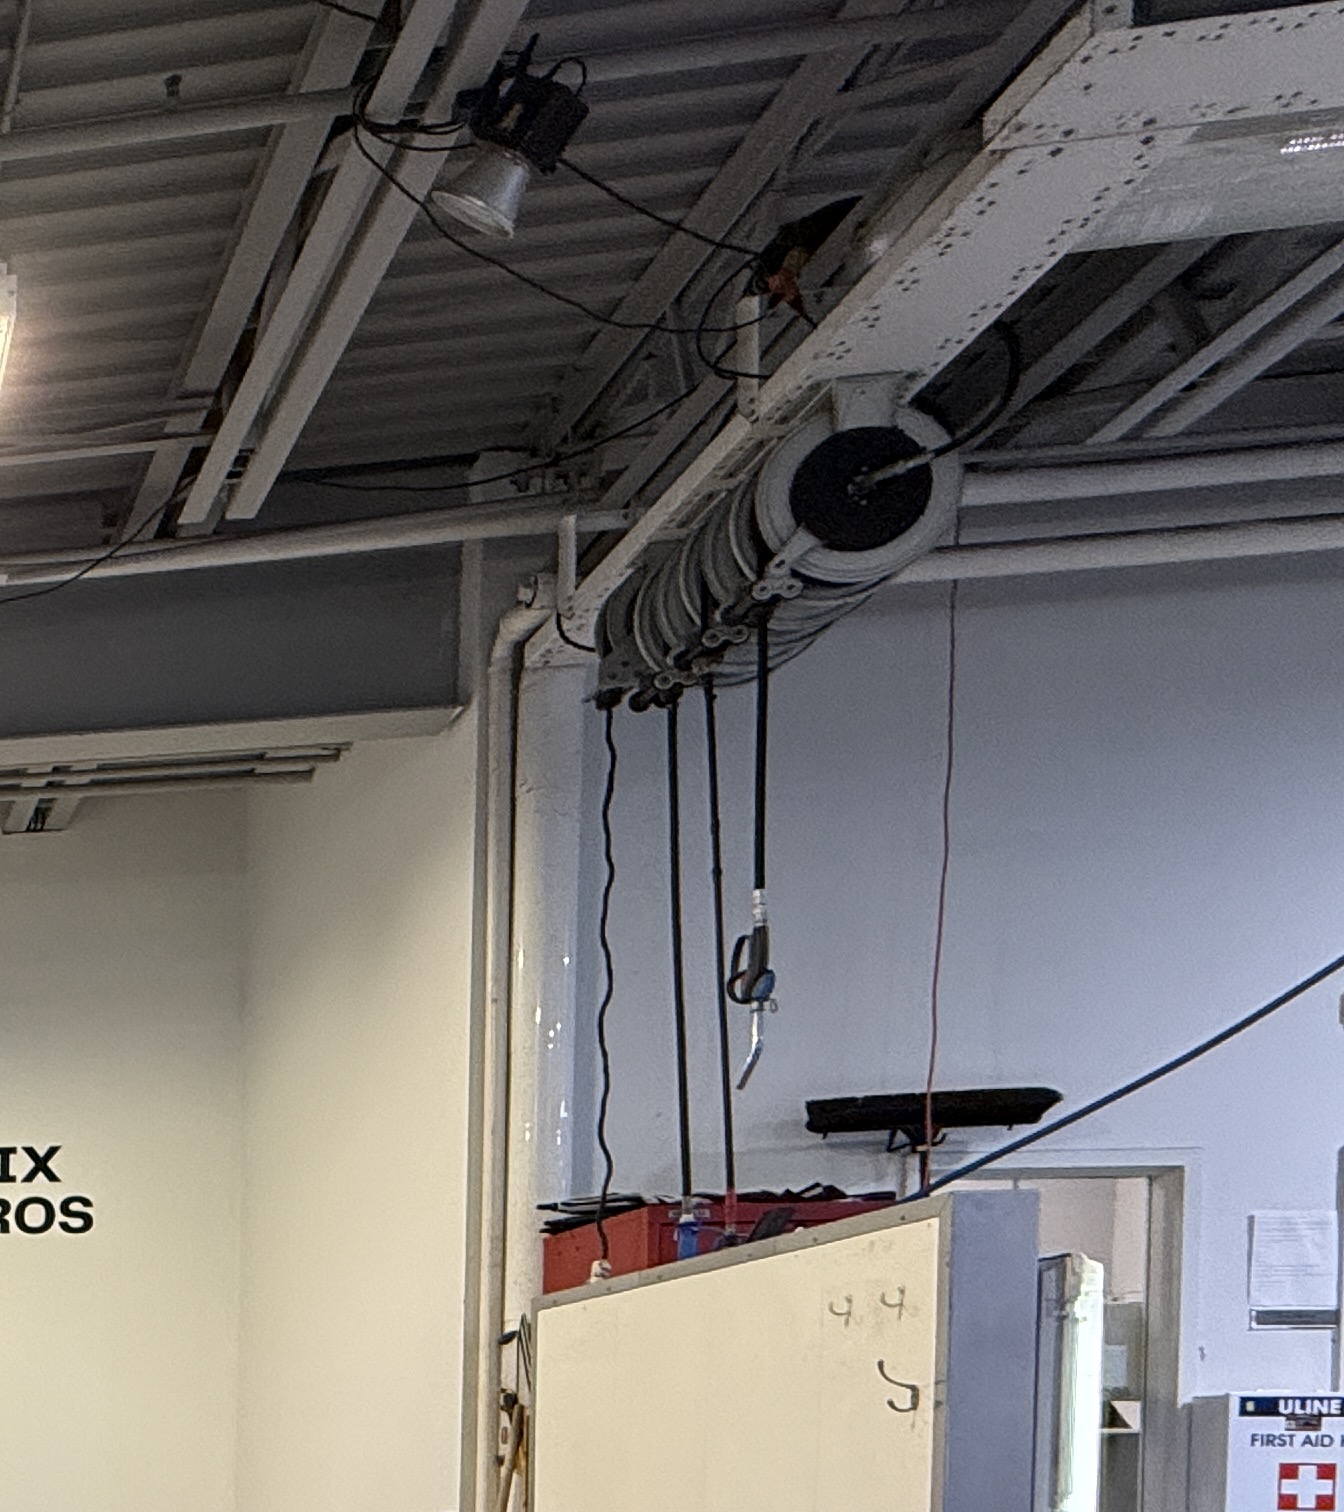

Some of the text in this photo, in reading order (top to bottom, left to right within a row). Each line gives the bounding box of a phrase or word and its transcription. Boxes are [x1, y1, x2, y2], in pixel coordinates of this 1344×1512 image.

[1278, 1398, 1342, 1416] ULINE
[1250, 1433, 1296, 1448] FIRST
[1300, 1434, 1335, 1448] AID
